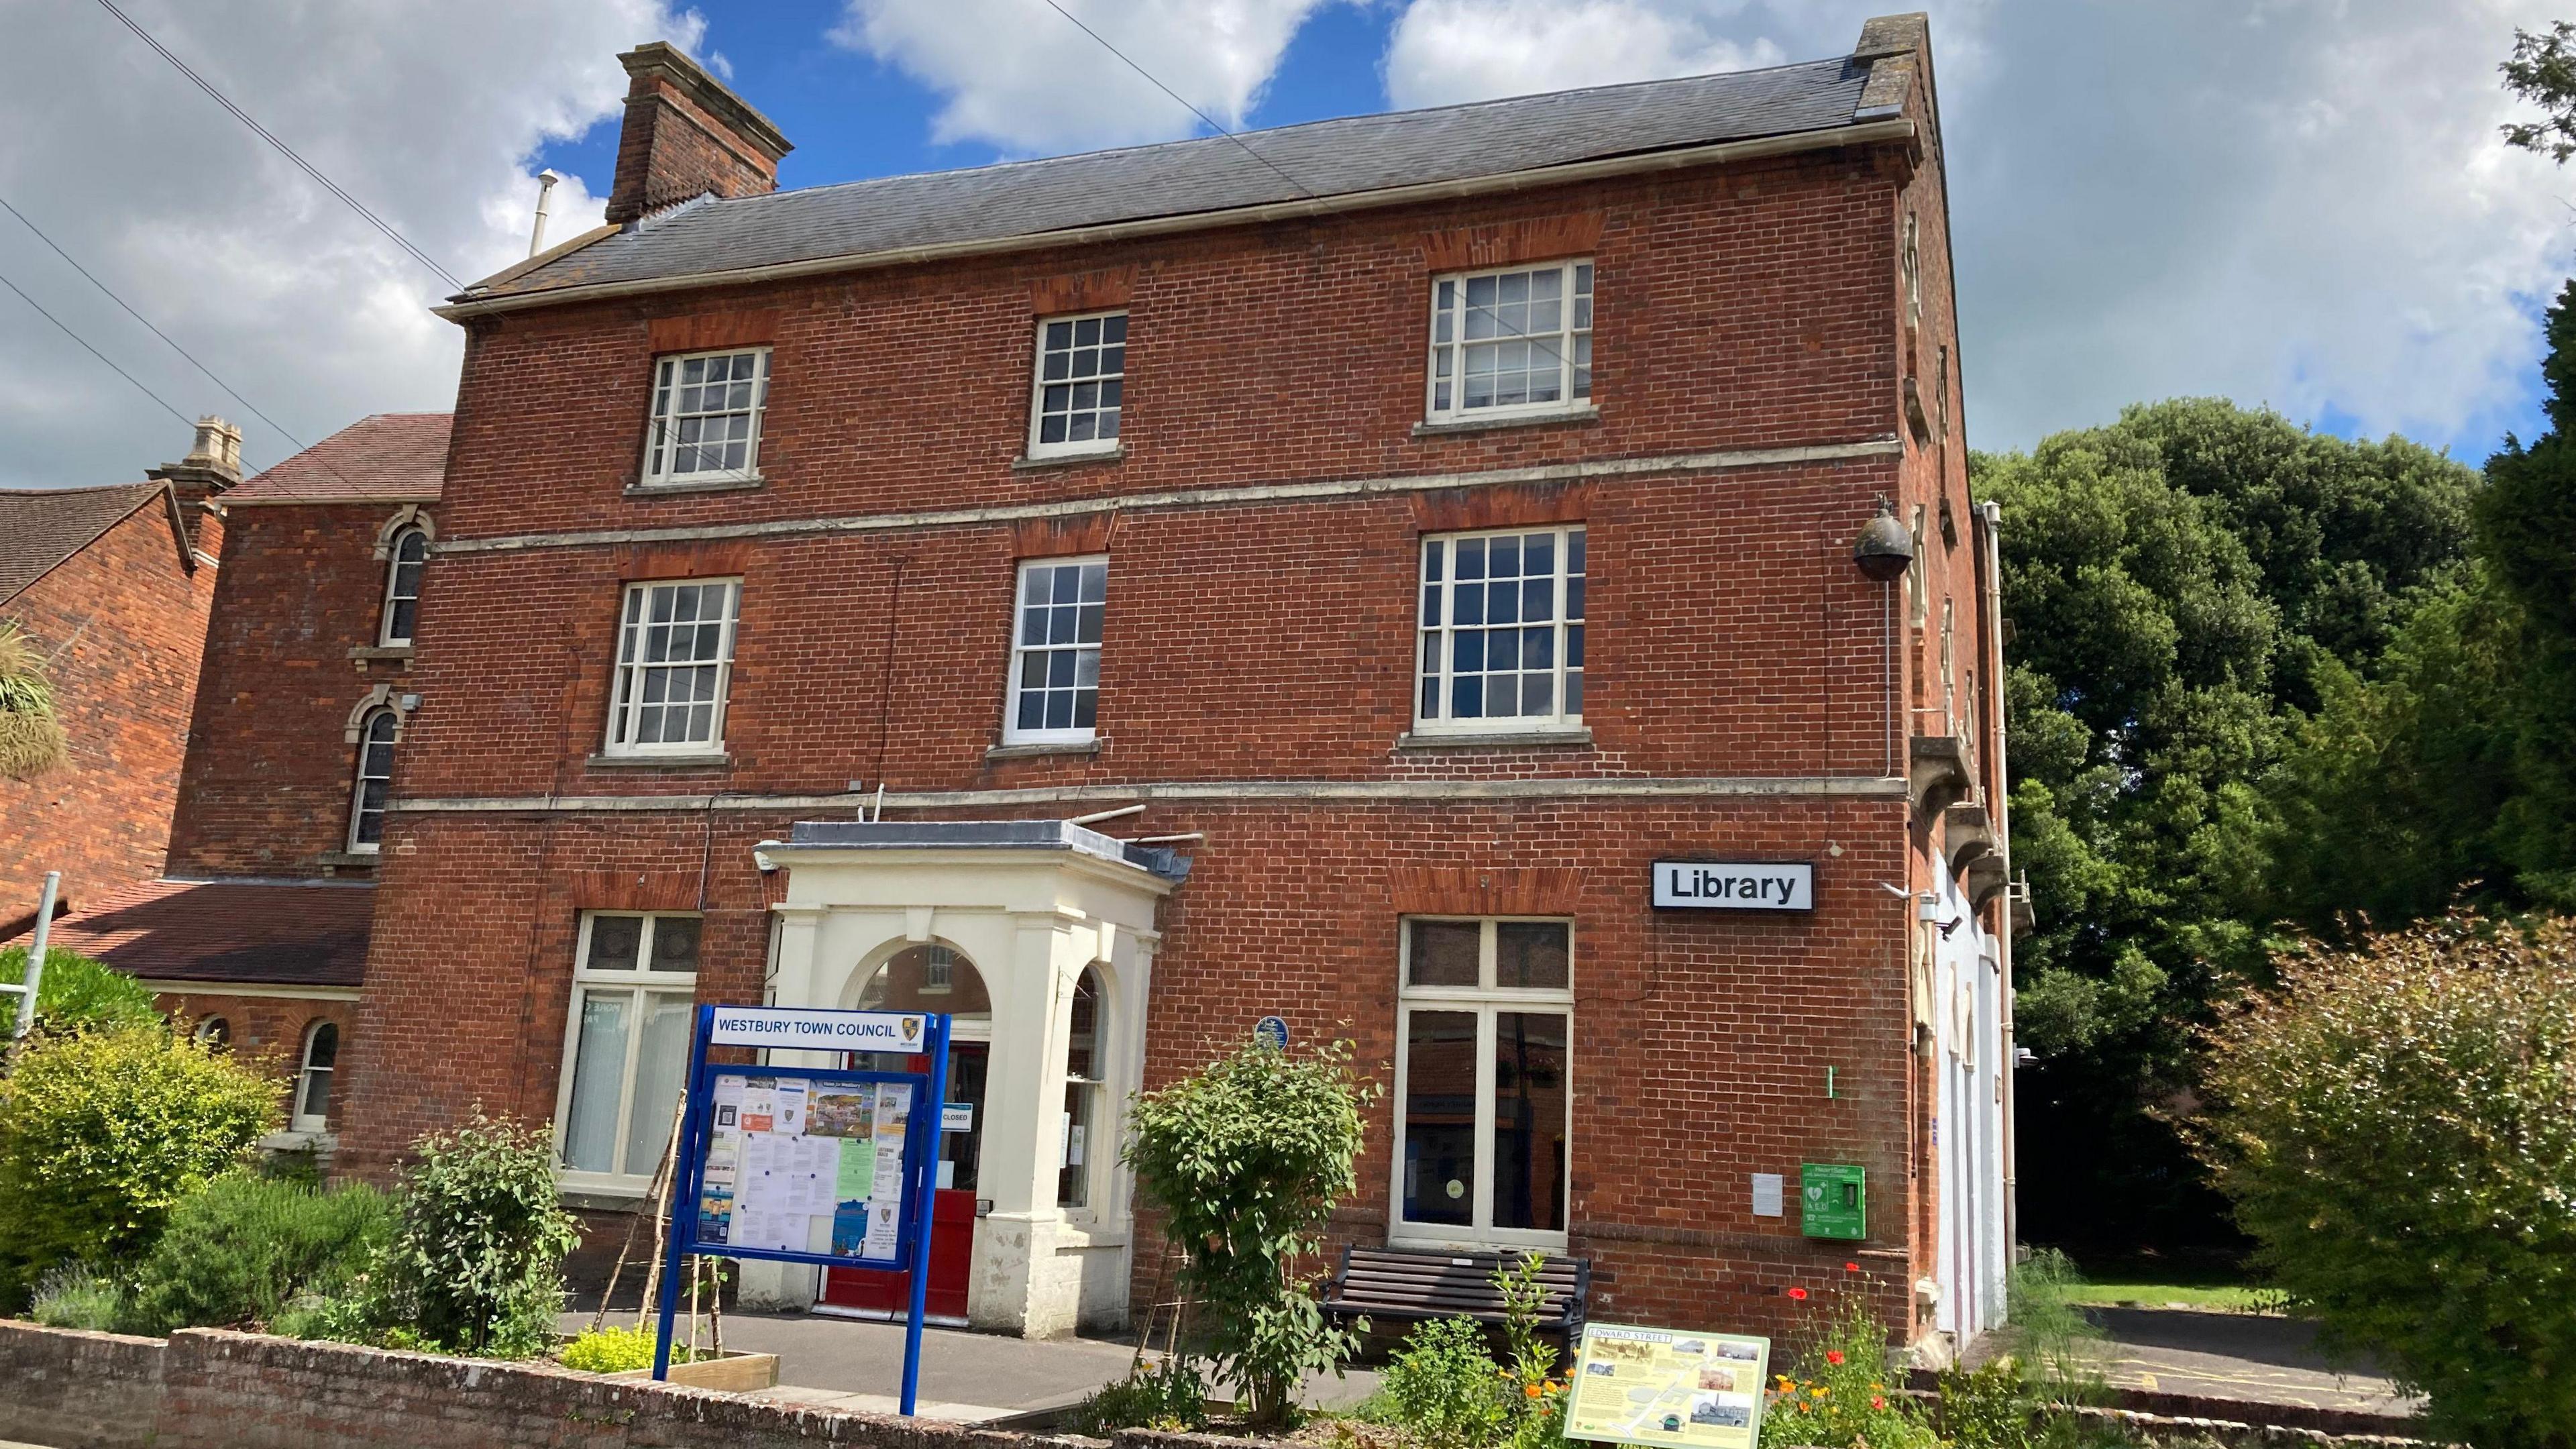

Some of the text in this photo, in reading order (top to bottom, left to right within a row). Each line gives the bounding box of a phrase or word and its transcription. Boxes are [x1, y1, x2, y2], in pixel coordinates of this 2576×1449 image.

[1671, 869, 1796, 905] Library
[719, 1018, 896, 1037] WESTBURY TOWN COUNCIL
[1590, 1328, 1670, 1342] EDWARD STREET
